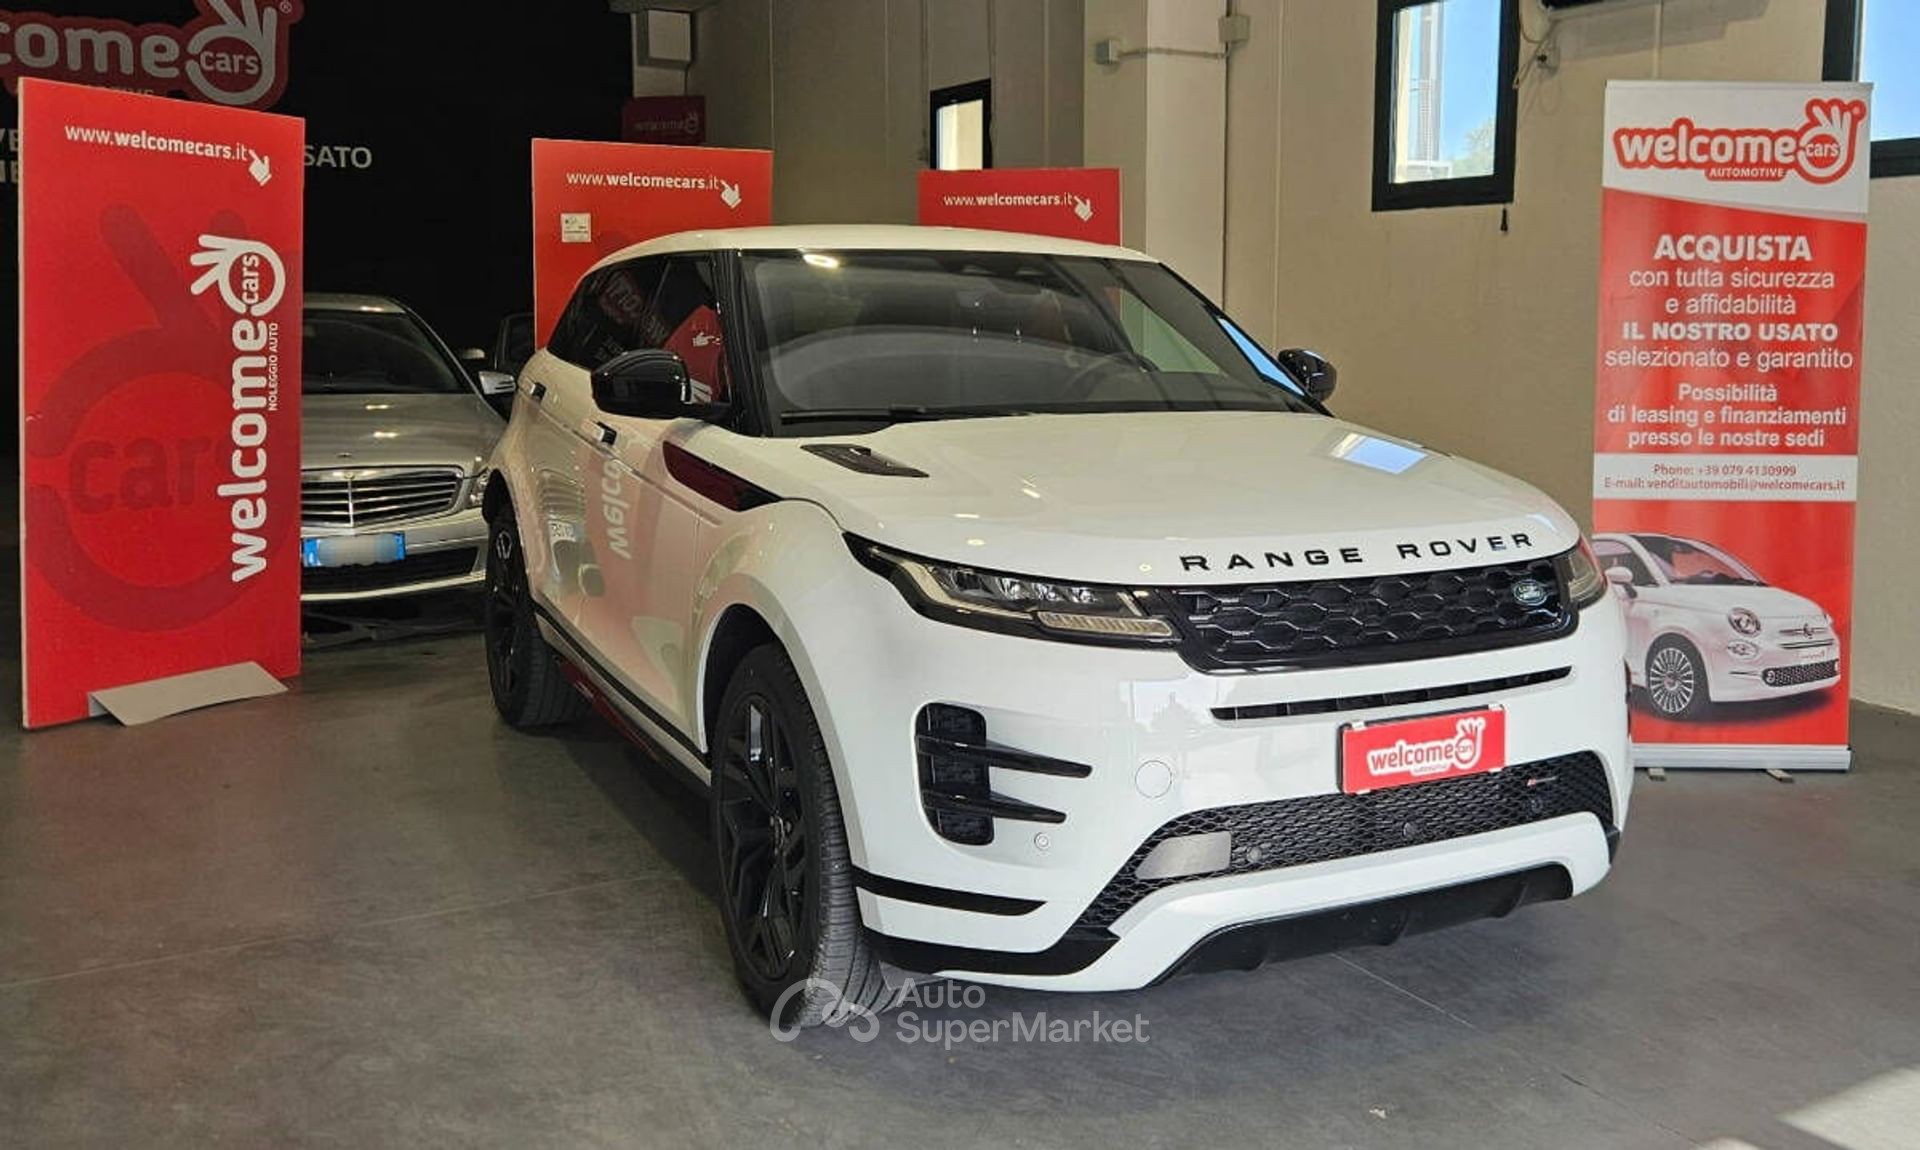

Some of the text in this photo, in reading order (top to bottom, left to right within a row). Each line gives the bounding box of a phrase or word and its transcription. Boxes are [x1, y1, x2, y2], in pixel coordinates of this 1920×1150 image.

[200, 49, 259, 74] cars
[65, 125, 248, 161] www.welcomecars.it
[1619, 125, 1840, 163] welcome cars
[566, 172, 719, 190] www.welcomecars.it
[1709, 167, 1785, 178] AUTOMOTIVE
[943, 192, 1073, 207] www.welcomecars.it
[1654, 235, 1813, 262] ACQUISTA
[1629, 268, 1835, 288] con tutta sicurezza
[1665, 295, 1796, 315] e affidabilità
[1623, 322, 1838, 341] IL NOSTRO USATO
[268, 322, 279, 411] NOLEGGIO AUTO
[1605, 346, 1853, 372] selezionato e garantito
[1678, 383, 1778, 402] Possibilità
[217, 254, 267, 583] welcome cars
[1608, 405, 1847, 427] di leasing e finanziamenti
[1628, 429, 1825, 448] presso le nostre sedi
[1654, 464, 1694, 475] Phone:
[1722, 464, 1744, 475] 079
[1604, 477, 1645, 488] E-mail:
[1179, 533, 1534, 571] RANGE ROVER
[1371, 743, 1454, 771] welcome
